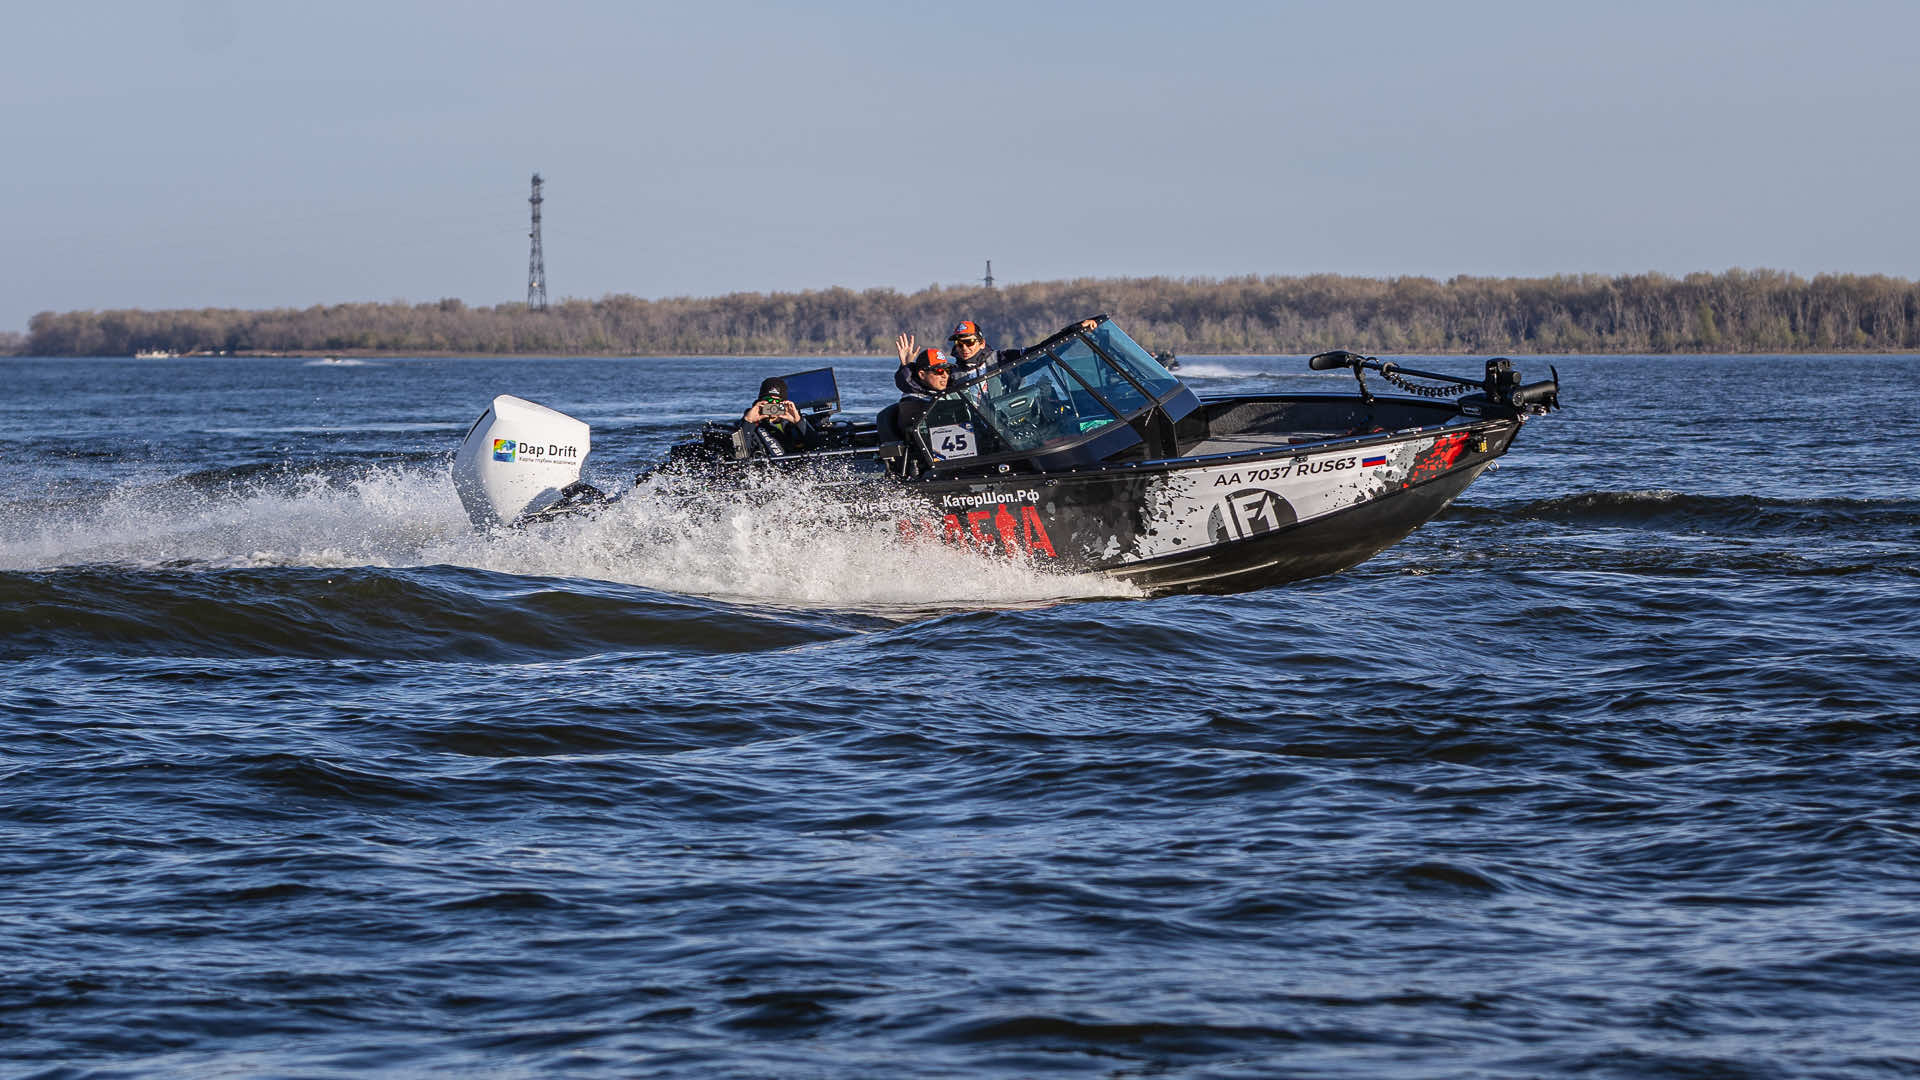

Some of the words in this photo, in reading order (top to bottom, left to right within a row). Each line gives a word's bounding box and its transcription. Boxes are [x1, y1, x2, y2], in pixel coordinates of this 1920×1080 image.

[519, 442, 544, 457] Dap
[548, 444, 577, 458] Drift
[941, 434, 968, 451] 45
[1214, 472, 1241, 487] AA
[1248, 466, 1292, 483] 7037
[1296, 456, 1357, 476] RUS63
[943, 489, 1040, 508] КатерШоп.Рф
